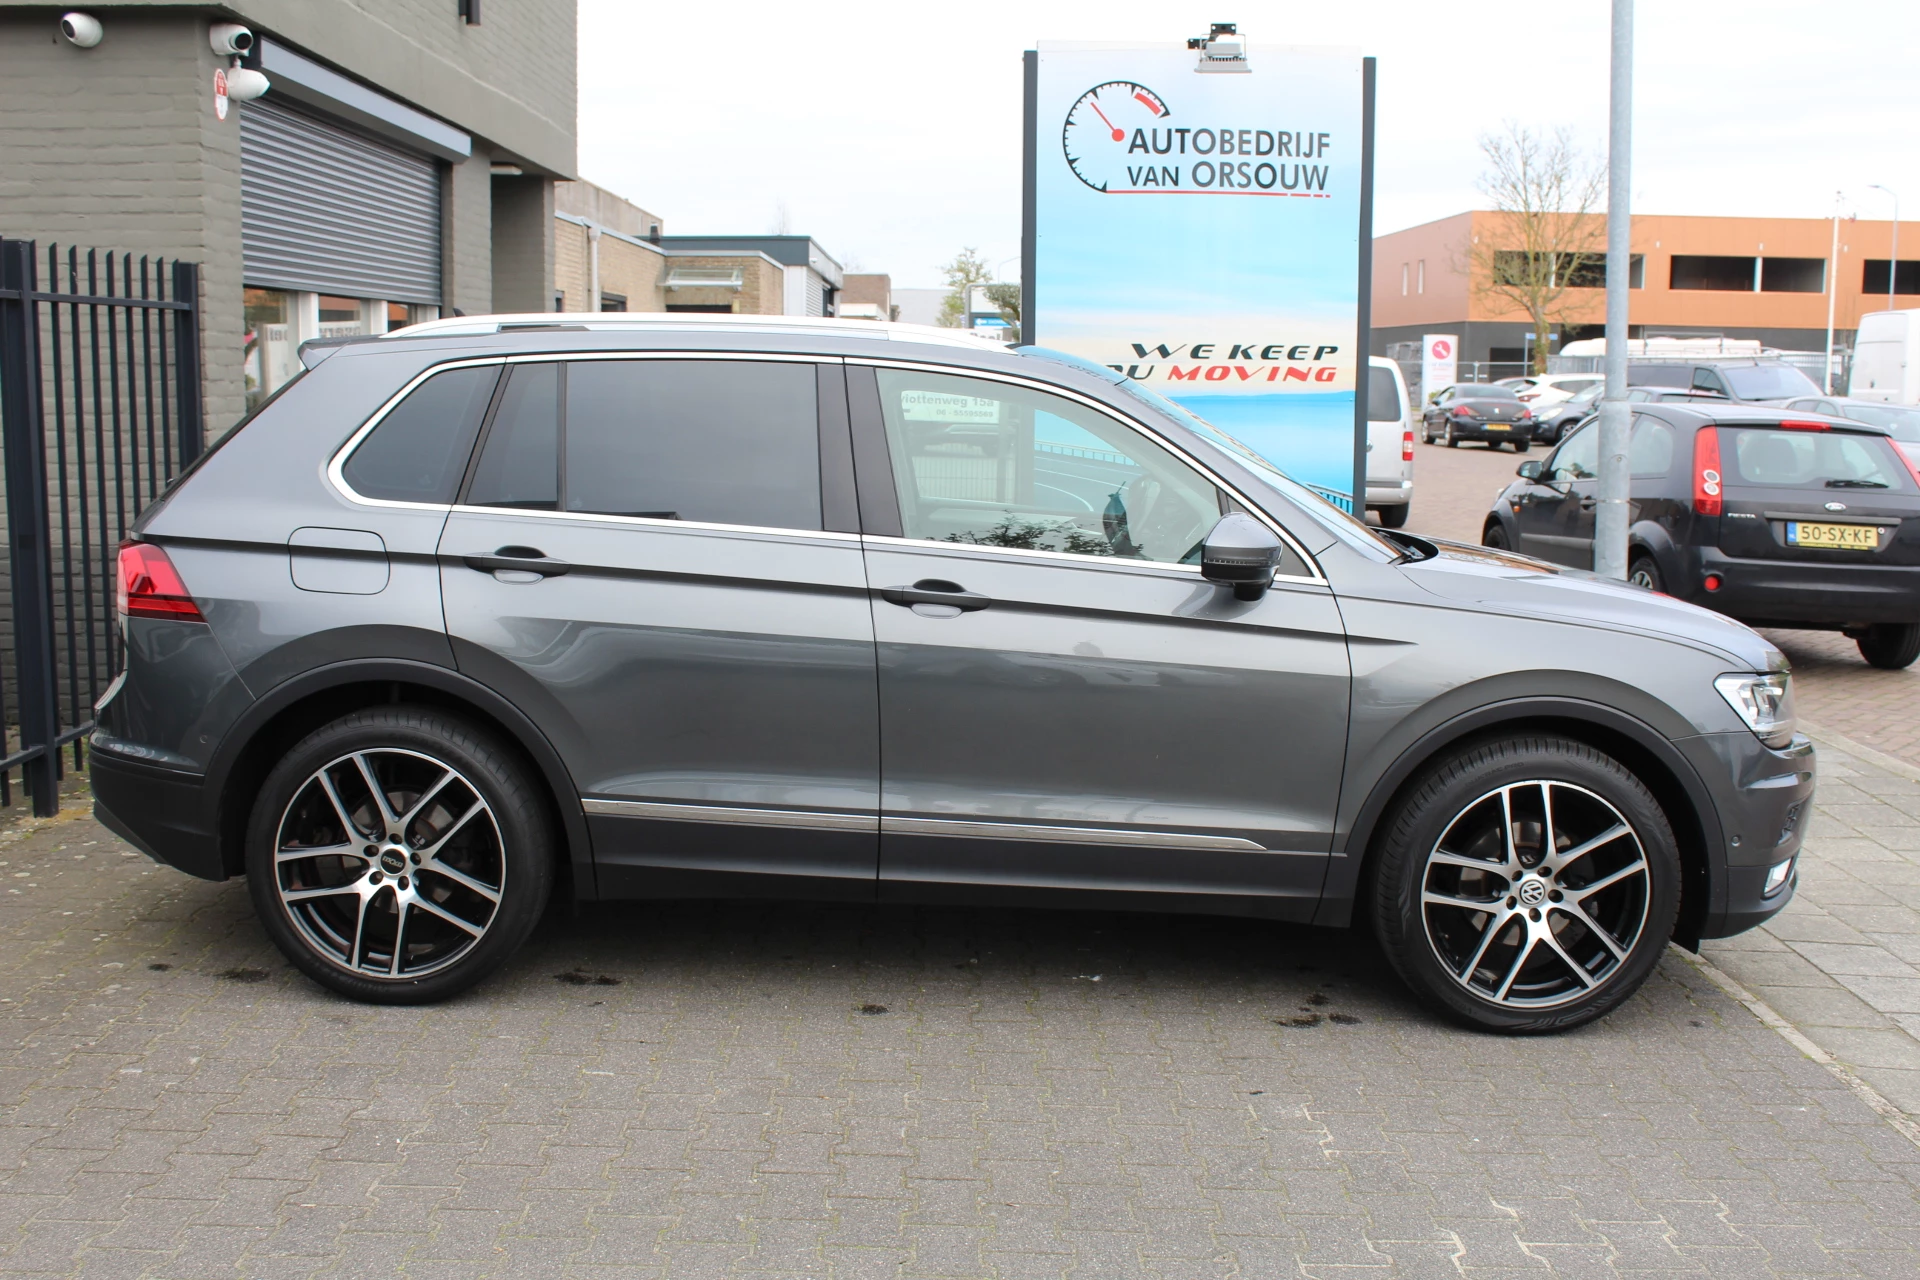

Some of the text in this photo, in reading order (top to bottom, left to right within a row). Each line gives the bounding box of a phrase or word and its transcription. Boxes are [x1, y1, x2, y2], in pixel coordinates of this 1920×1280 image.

[1128, 128, 1330, 159] AUTOBEDRIJF
[1127, 160, 1329, 190] VAN ORSOUW
[1131, 343, 1339, 361] WE KEEP
[1167, 365, 1337, 382] MOVING
[1801, 525, 1872, 543] 50-SX-KF
